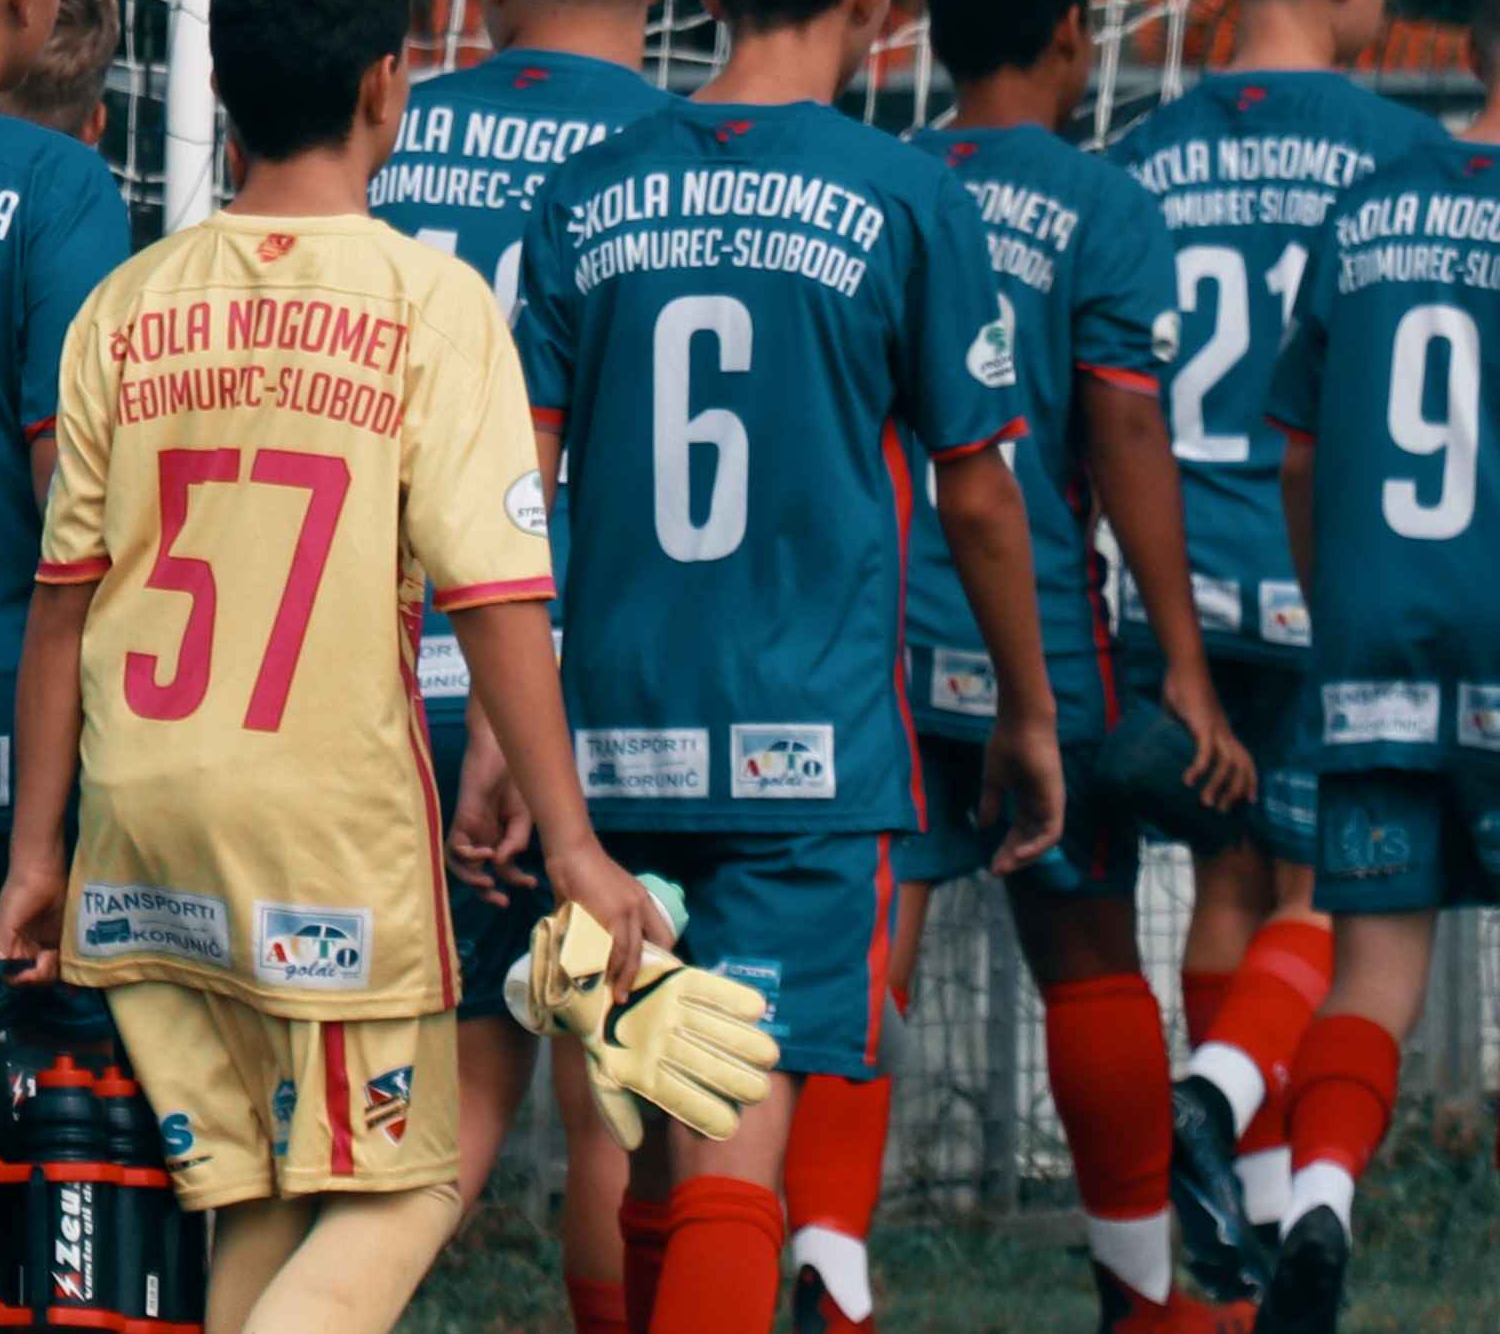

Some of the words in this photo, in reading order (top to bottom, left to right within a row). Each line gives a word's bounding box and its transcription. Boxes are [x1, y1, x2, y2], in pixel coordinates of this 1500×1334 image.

[681, 170, 885, 252] NOGOMETA
[227, 298, 409, 375] NOGOMET
[653, 295, 753, 562] 6
[1382, 304, 1481, 540] 9
[123, 448, 351, 733] 57
[83, 891, 215, 920] TRANSPORTI
[55, 1183, 81, 1273] Zeu
